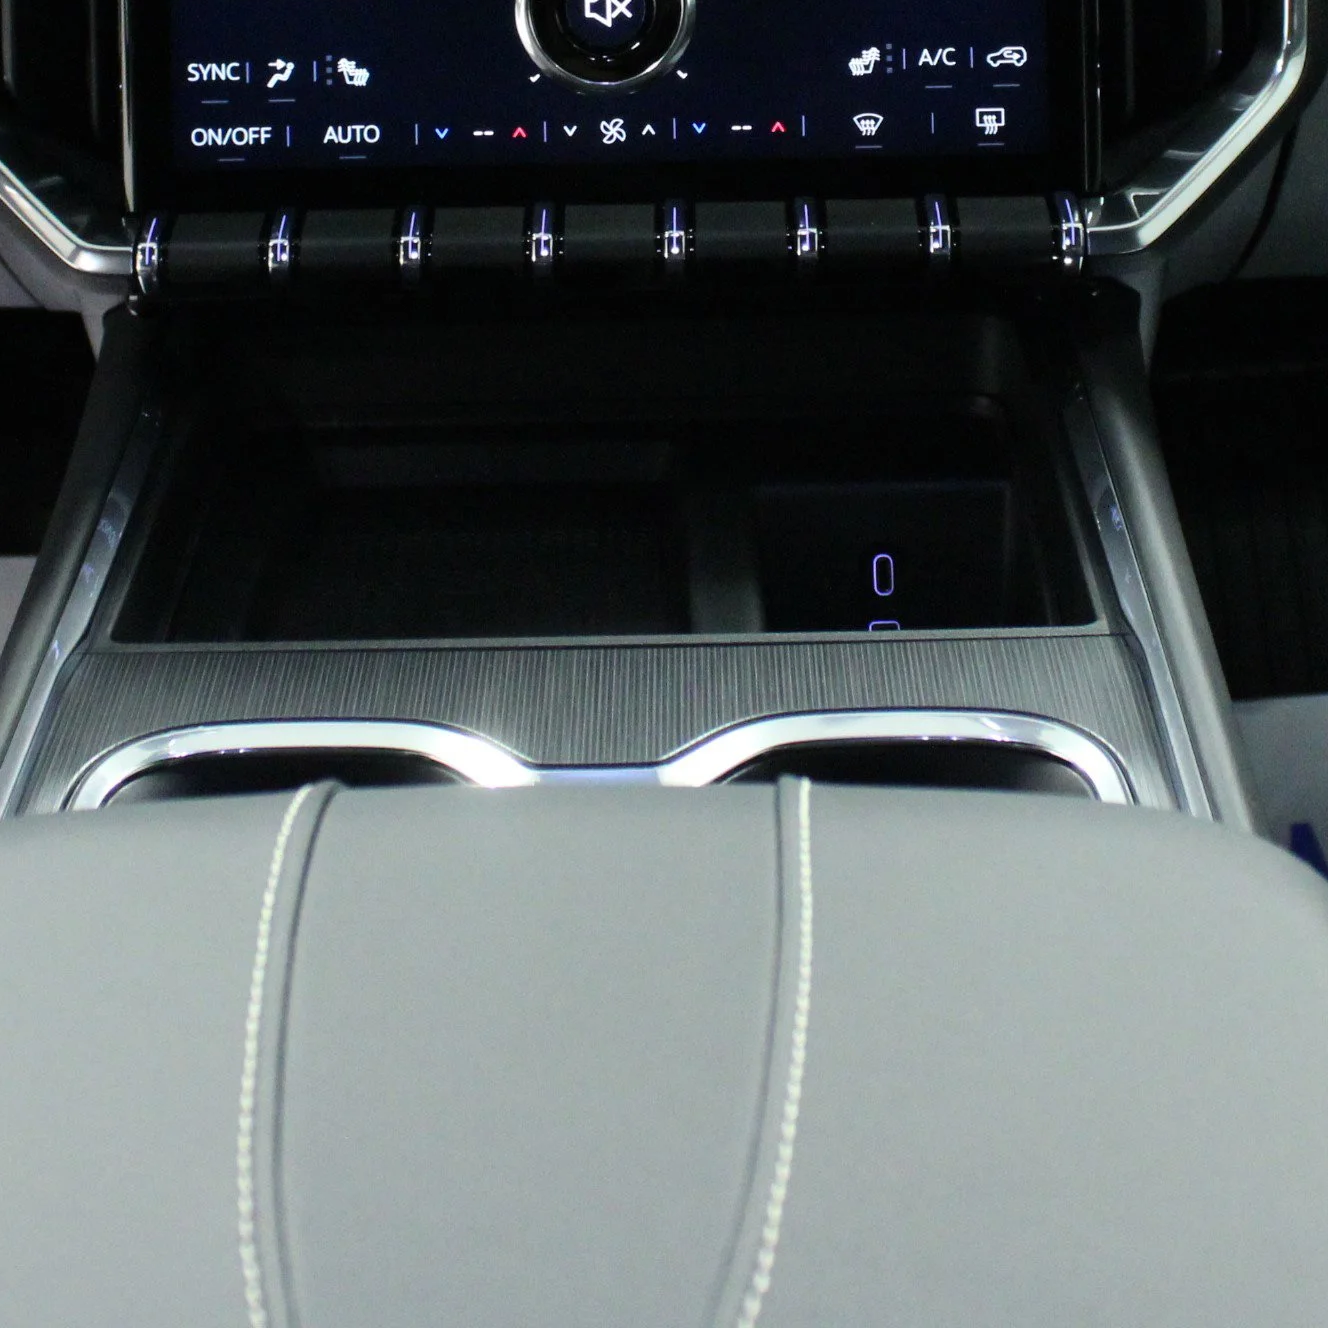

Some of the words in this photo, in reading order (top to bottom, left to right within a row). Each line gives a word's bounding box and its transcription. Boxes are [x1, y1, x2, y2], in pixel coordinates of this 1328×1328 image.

[918, 47, 957, 67] A/C
[187, 61, 241, 83] SYNC
[190, 126, 273, 147] ON/OFF
[323, 124, 381, 144] AUTO
